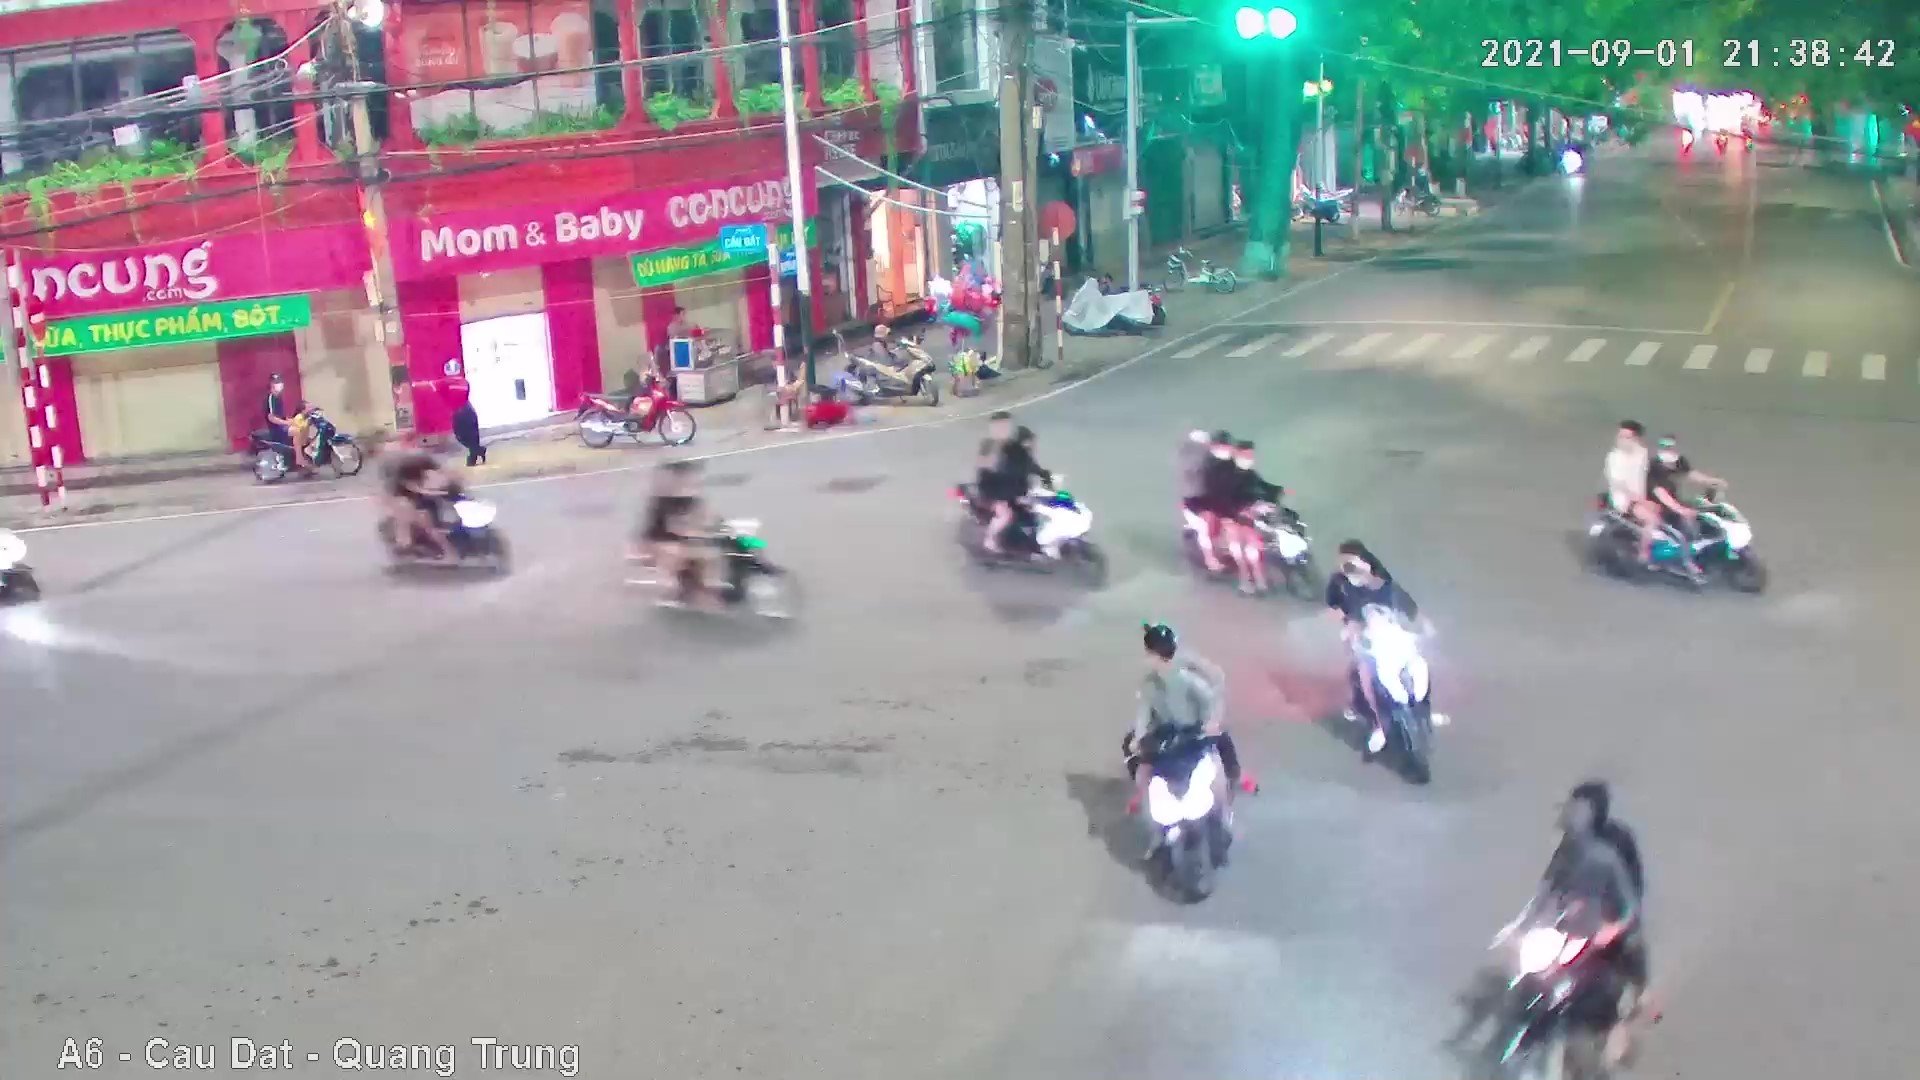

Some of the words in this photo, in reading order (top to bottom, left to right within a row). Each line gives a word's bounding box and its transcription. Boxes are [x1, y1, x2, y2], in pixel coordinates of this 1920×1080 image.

[420, 223, 519, 263] Mom
[525, 221, 547, 247] &
[554, 205, 644, 243] Baby
